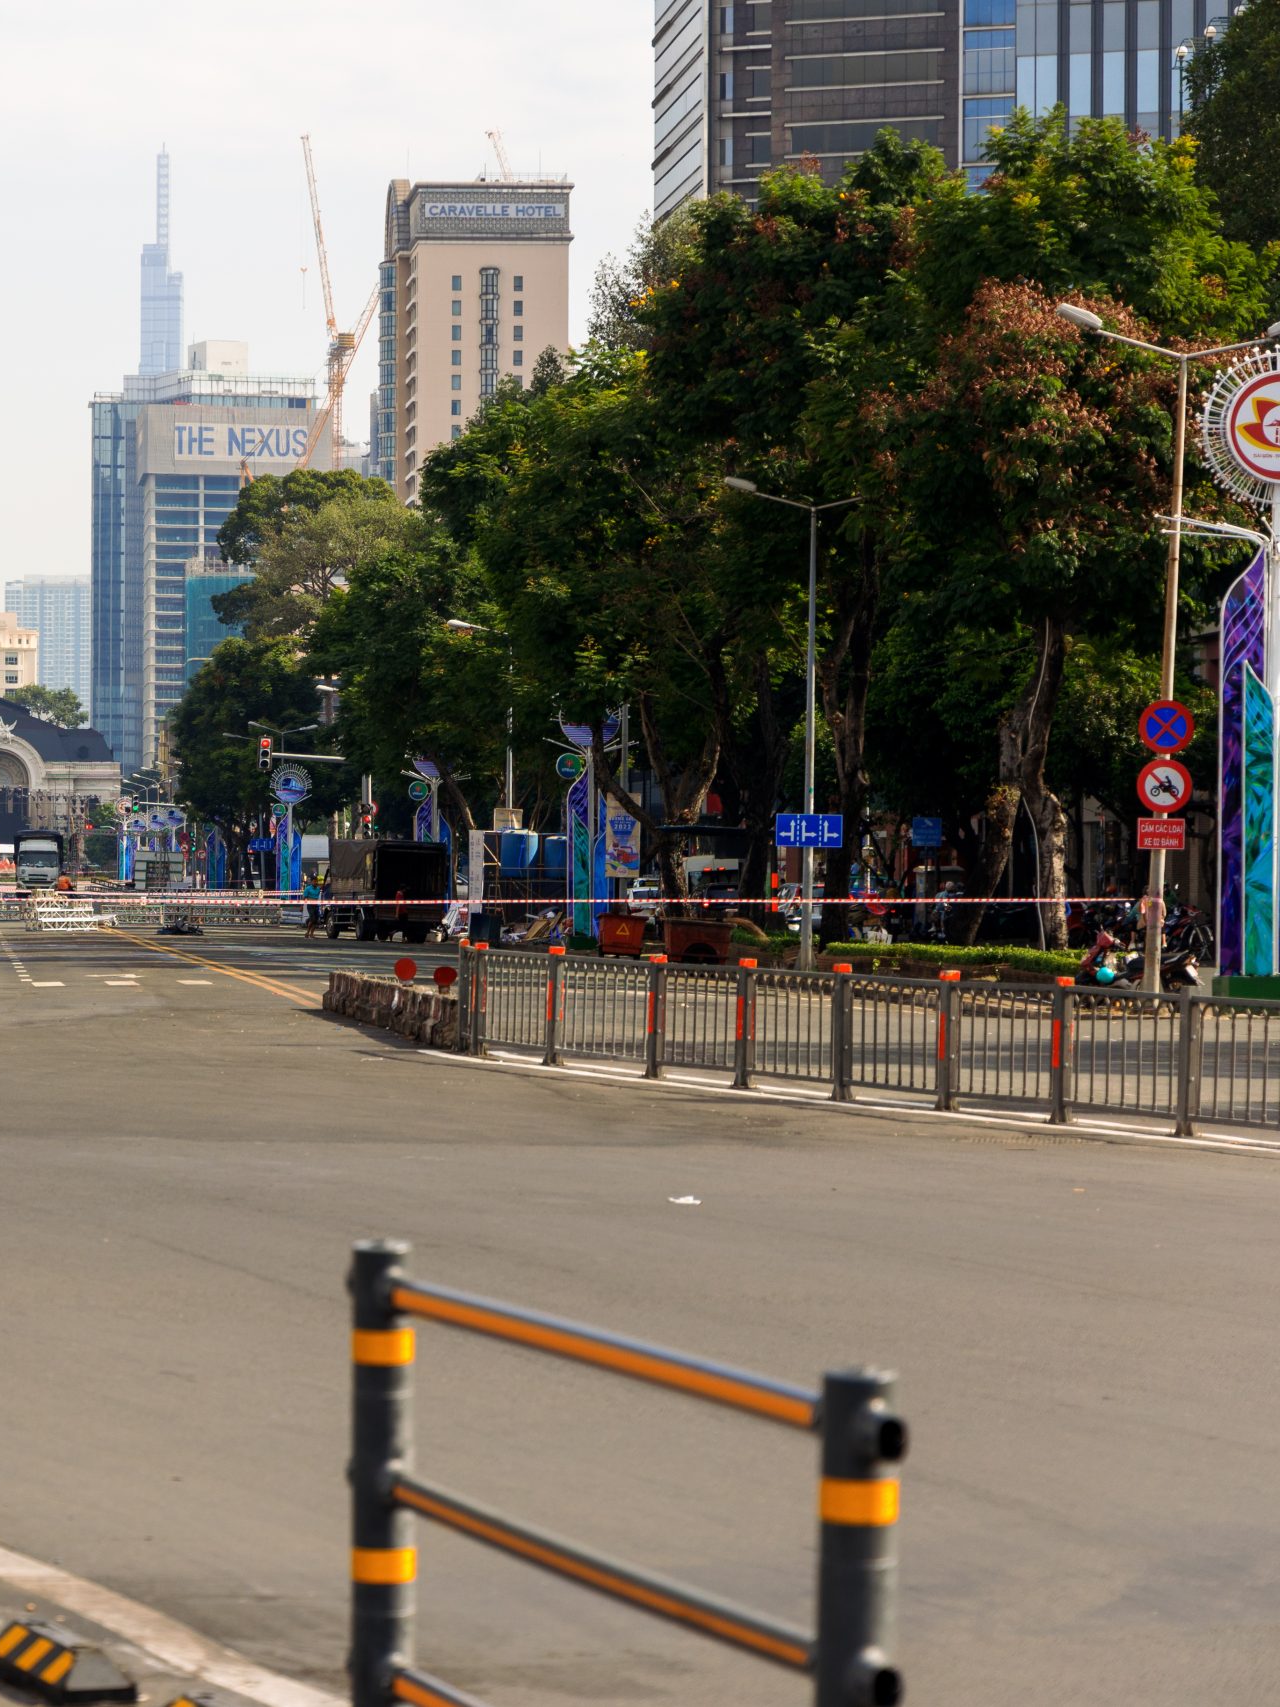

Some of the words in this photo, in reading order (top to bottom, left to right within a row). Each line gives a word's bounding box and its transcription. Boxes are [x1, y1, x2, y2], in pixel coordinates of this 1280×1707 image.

[428, 205, 510, 217] CARAVELLE
[515, 205, 562, 217] HOTEL
[174, 426, 215, 456] THE
[227, 427, 308, 458] NEXUS
[1144, 837, 1153, 846] XE
